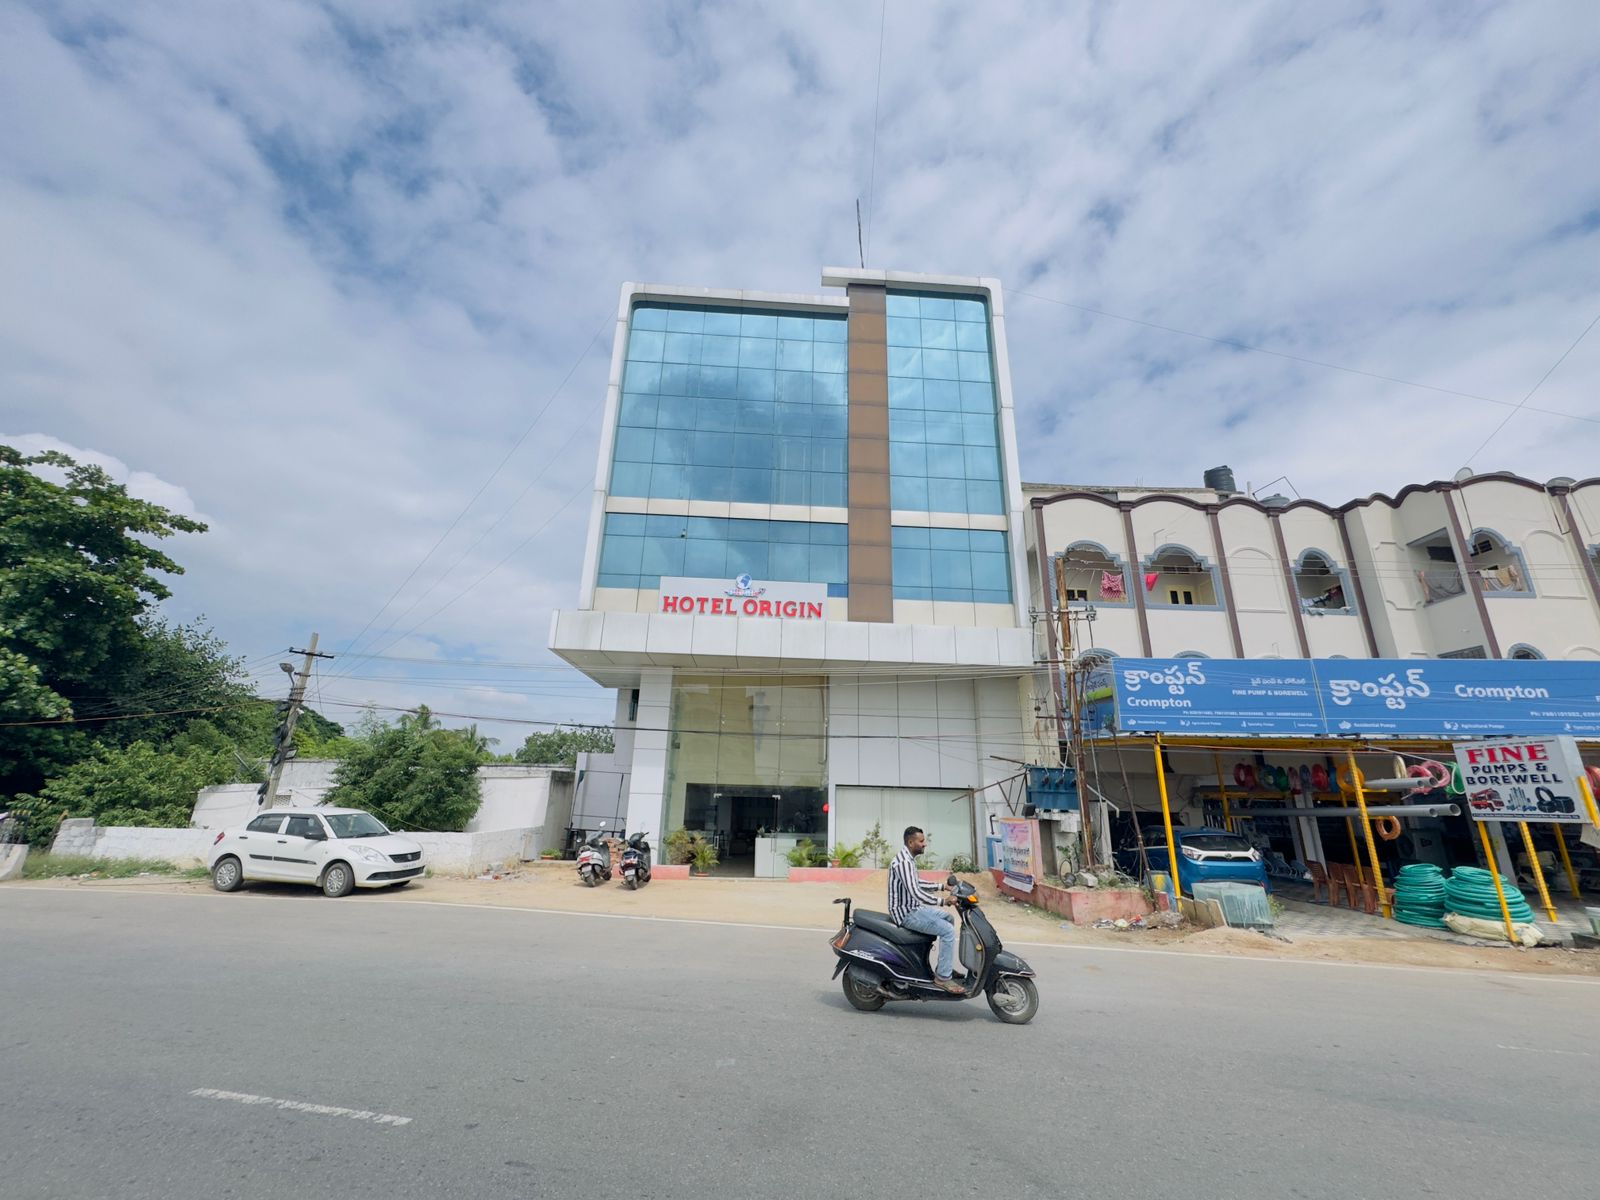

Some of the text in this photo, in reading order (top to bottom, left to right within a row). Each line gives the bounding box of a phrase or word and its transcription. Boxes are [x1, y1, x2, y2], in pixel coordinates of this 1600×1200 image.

[662, 595, 823, 619] HOTEL ORIGIN
[1454, 684, 1549, 701] Crompton
[1127, 696, 1192, 709] Crompton
[1466, 744, 1549, 765] FINE
[1471, 762, 1547, 774] PUMPS &
[1465, 773, 1563, 785] BOREWELL
